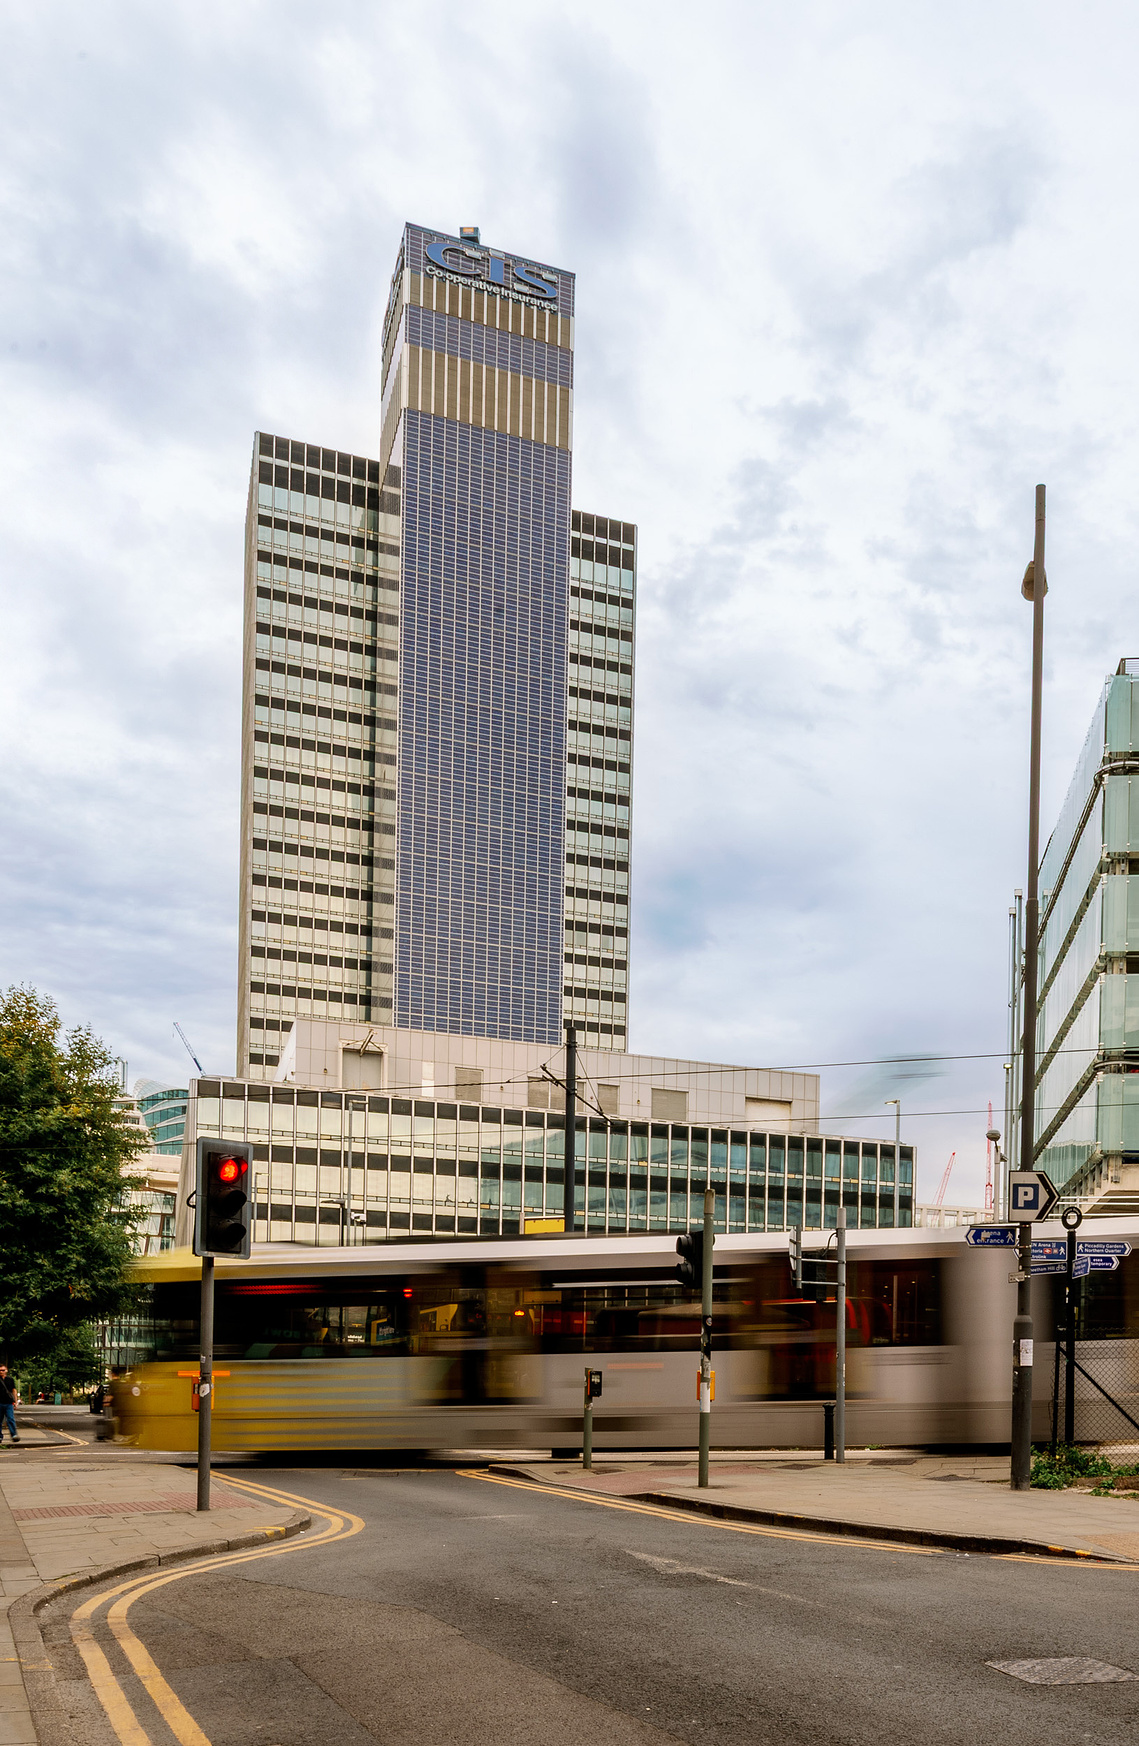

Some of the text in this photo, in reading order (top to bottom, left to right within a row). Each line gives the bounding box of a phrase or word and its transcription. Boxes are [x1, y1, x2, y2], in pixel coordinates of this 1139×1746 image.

[426, 242, 558, 298] CIS
[501, 287, 558, 311] Insurance
[1018, 1187, 1034, 1207] P
